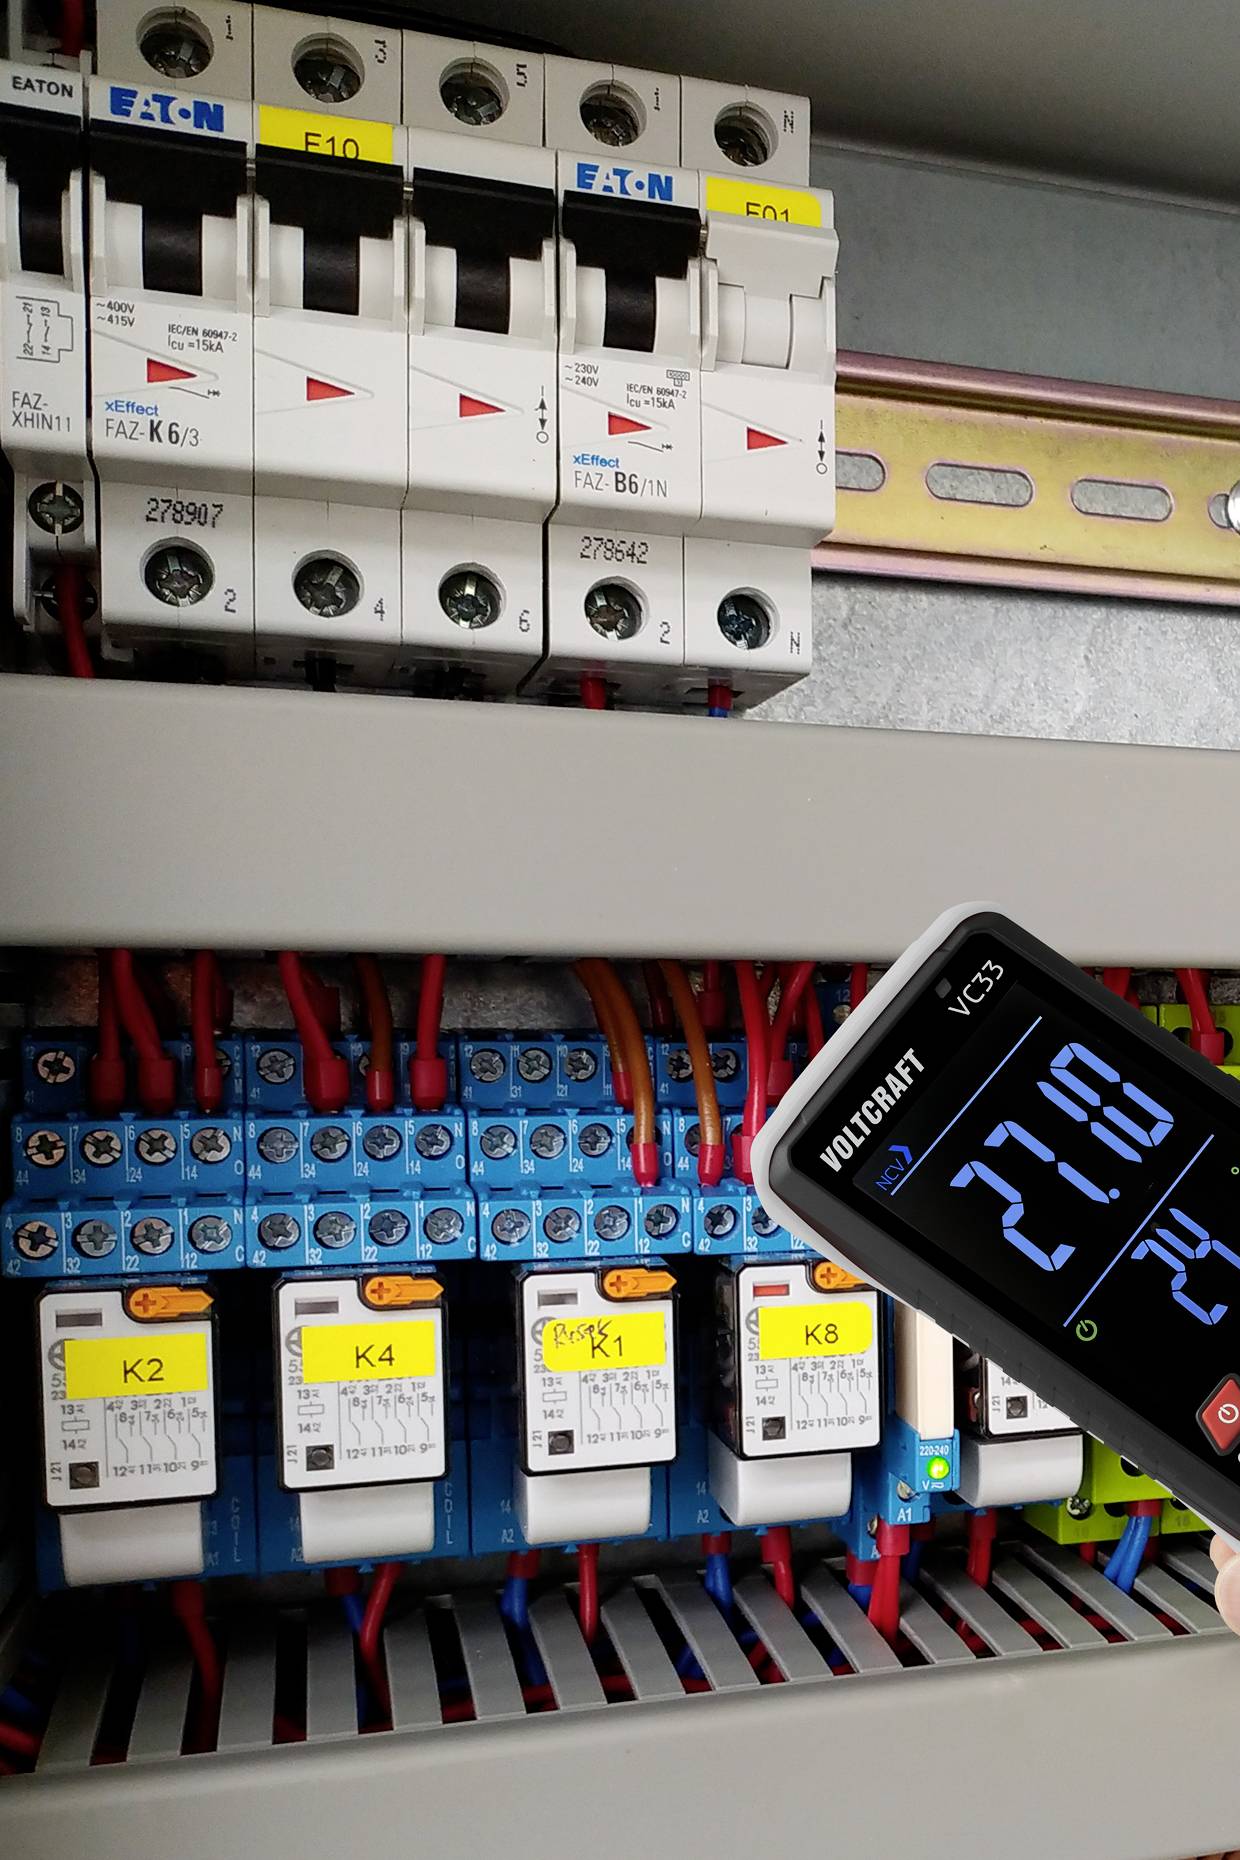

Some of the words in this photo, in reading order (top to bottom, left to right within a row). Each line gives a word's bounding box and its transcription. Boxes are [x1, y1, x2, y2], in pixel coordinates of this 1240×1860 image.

[12, 76, 74, 98] EATON
[110, 86, 225, 133] EATON
[305, 131, 360, 160] F10
[577, 162, 674, 202] EATON
[168, 323, 199, 336] IEC/EN
[12, 391, 49, 410] FAZ-
[104, 400, 159, 417] xEffect
[12, 411, 71, 432] XHIN11
[572, 453, 620, 469] xEffect
[145, 497, 224, 529] 278907
[580, 535, 650, 565] 278642
[948, 958, 1005, 1019] VC33
[819, 1048, 925, 1172] VOLTCRAFT
[875, 1158, 904, 1191] NCV
[591, 1334, 623, 1359] K1
[805, 1323, 839, 1346] K8
[355, 1343, 395, 1368] K4
[123, 1358, 164, 1384] K2
[919, 1445, 950, 1456] 220-240
[897, 1507, 912, 1522] A1
[502, 1528, 514, 1543] A2
